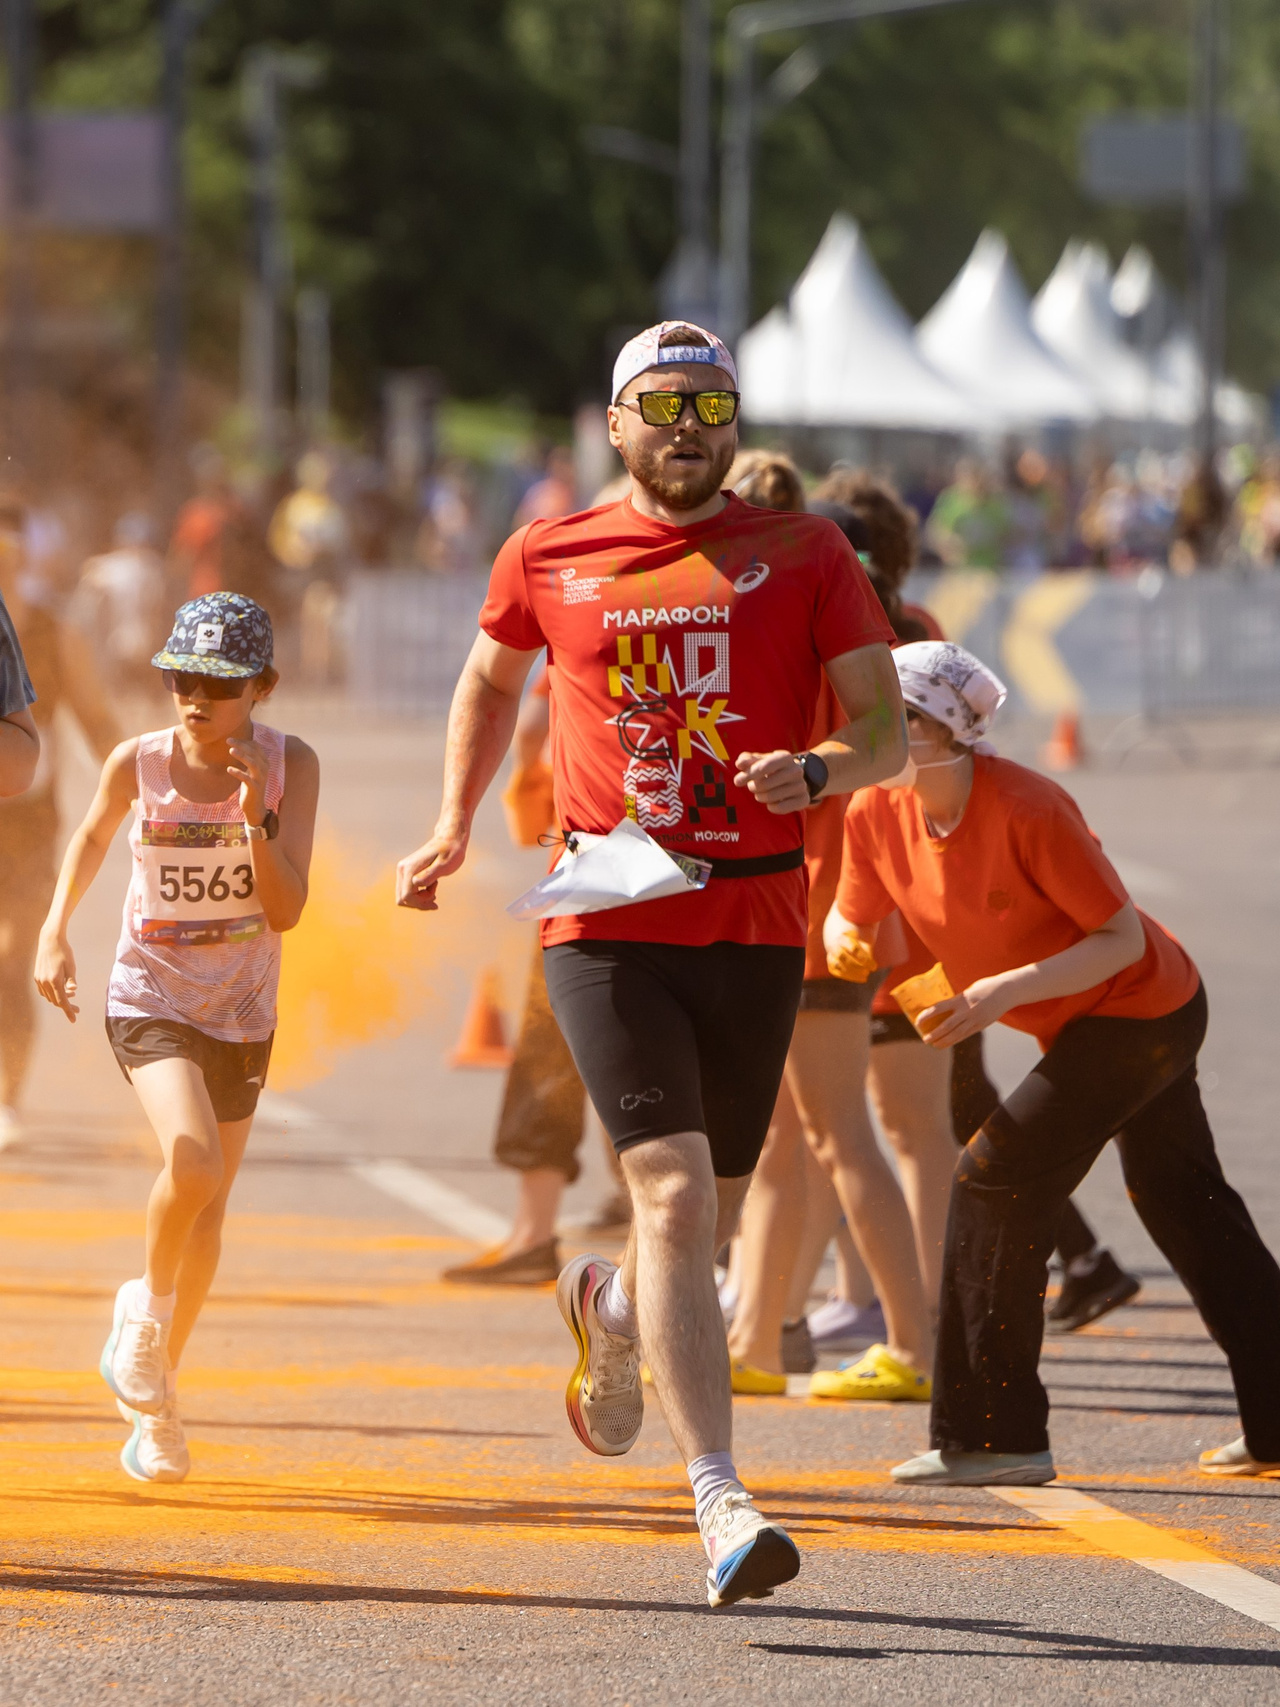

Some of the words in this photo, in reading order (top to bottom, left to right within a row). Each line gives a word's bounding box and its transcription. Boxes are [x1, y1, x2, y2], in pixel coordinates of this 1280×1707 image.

[603, 605, 730, 629] МАРАФОН
[694, 830, 739, 842] MOSCOW
[160, 864, 253, 903] 5563
